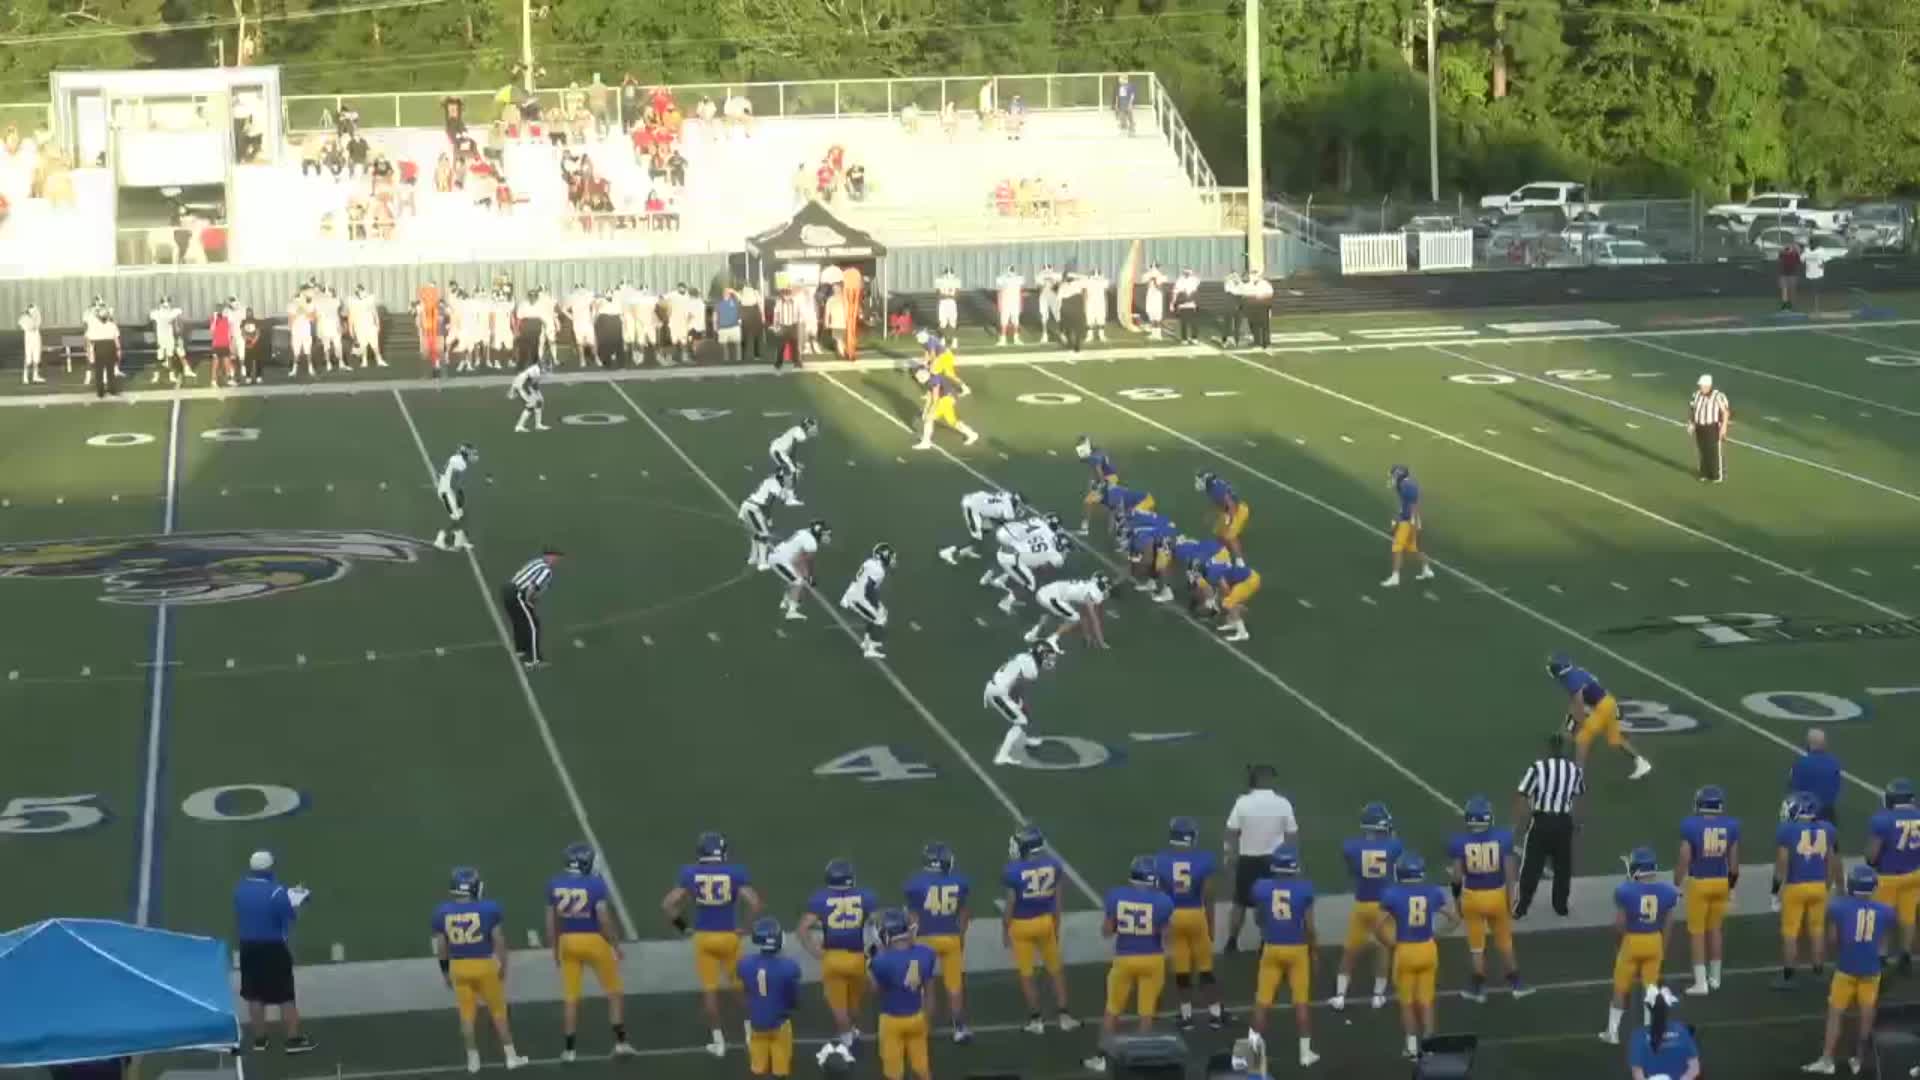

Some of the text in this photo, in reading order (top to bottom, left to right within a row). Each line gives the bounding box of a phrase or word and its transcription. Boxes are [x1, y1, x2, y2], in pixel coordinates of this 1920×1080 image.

[1703, 827, 1728, 857] 16
[1797, 829, 1829, 858] 44
[1464, 842, 1500, 874] 80
[694, 874, 732, 905] 33
[1021, 867, 1057, 899] 32
[1172, 862, 1191, 893] 5
[553, 888, 591, 918] 22
[826, 896, 864, 929] 25
[923, 885, 960, 916] 46
[1271, 889, 1292, 920] 6
[1408, 896, 1428, 926] 8
[1640, 895, 1659, 923] 9
[445, 912, 484, 945] 62
[1116, 901, 1154, 936] 53
[1855, 909, 1877, 942] 11
[757, 969, 767, 996] 1
[904, 960, 921, 990] 4
